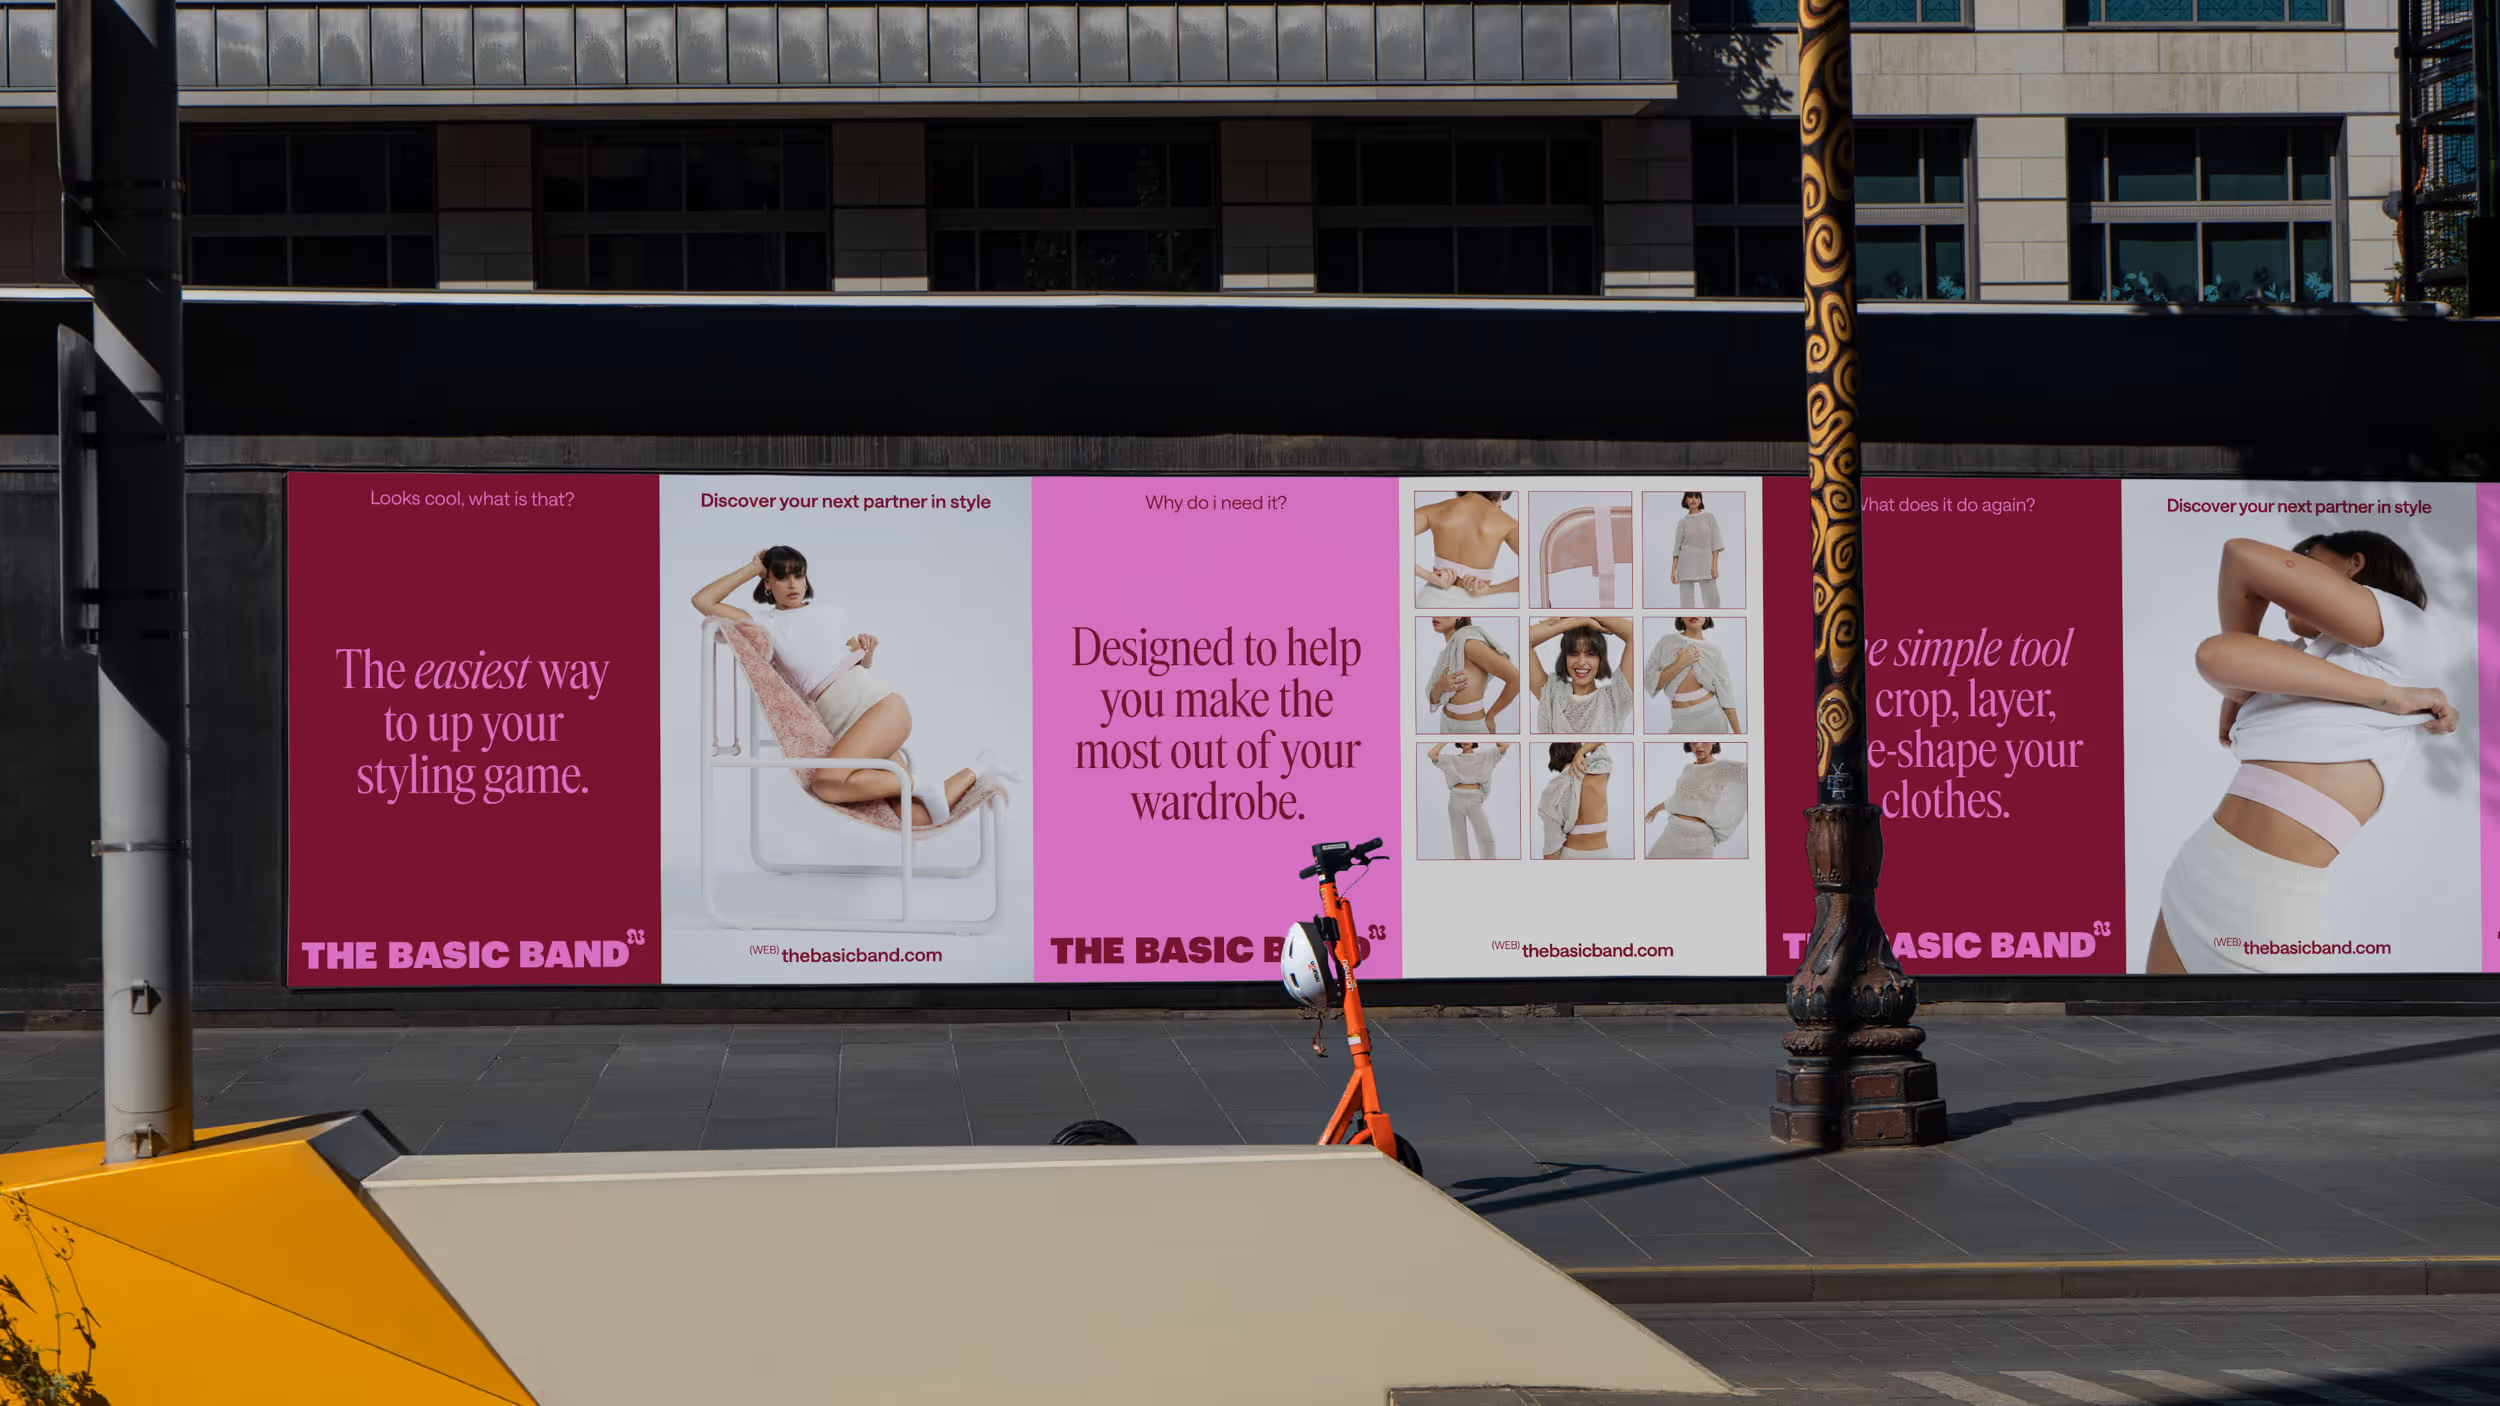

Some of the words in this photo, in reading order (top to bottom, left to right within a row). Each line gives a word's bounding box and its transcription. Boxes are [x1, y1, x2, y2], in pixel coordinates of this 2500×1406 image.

[371, 490, 420, 505] Looks
[425, 490, 464, 507] cool,
[468, 491, 510, 506] what
[515, 491, 527, 506] is
[531, 491, 574, 506] that?
[701, 493, 776, 508] Discover
[779, 497, 819, 511] your
[822, 495, 859, 508] next
[864, 495, 928, 511] partner
[931, 494, 946, 508] in
[950, 494, 991, 512] style
[1146, 495, 1183, 513] Why
[1187, 496, 1208, 509] do
[1214, 496, 1216, 510] i
[1222, 496, 1263, 510] need
[1268, 496, 1287, 509] it?
[1899, 497, 1938, 512] does
[1943, 497, 1952, 512] it
[1957, 497, 1978, 512] do
[1982, 498, 2035, 515] again?
[2167, 498, 2238, 513] Discover
[2239, 502, 2275, 517] your
[2277, 500, 2313, 514] next
[2315, 500, 2375, 517] partner
[2377, 499, 2392, 514] in
[2394, 499, 2432, 518] style
[1071, 625, 1235, 677] Designed
[1244, 632, 1277, 666] to
[1287, 625, 1362, 677] help
[1893, 626, 2003, 677] simple
[2009, 626, 2076, 667] tool
[336, 648, 405, 689] The
[415, 650, 532, 689] easiest
[538, 661, 610, 700] way
[1099, 689, 1165, 728] you
[1174, 677, 1270, 718] make
[1278, 677, 1334, 718] the
[1875, 688, 1960, 728] crop,
[1967, 677, 2057, 728] layer,
[383, 706, 418, 742] to
[427, 712, 474, 753] up
[481, 712, 565, 753] your
[1075, 735, 1162, 770] most
[1170, 735, 1229, 770] out
[1236, 729, 1277, 770] of
[1280, 740, 1362, 780] your
[1867, 727, 1997, 779] e-shape
[2004, 739, 2085, 779] your
[357, 752, 477, 806] styling
[482, 764, 589, 805] game.
[1130, 779, 1306, 821] wardrobe.
[1881, 778, 2010, 819] clothes.
[301, 941, 378, 970] THE
[388, 940, 510, 970] BASIC
[519, 940, 630, 969] BAND
[750, 945, 779, 955] (WEB)
[782, 948, 942, 963] thebasicband.com
[1049, 936, 1126, 964] THE
[1136, 936, 1254, 964] BASIC
[1492, 940, 1520, 951] (WEB)
[1522, 943, 1674, 958] thebasicband.com
[1888, 931, 1982, 960] ASIC
[1990, 931, 2096, 959] BAND
[2213, 937, 2242, 947] (WEB)
[2243, 940, 2392, 955] thebasicband.com
